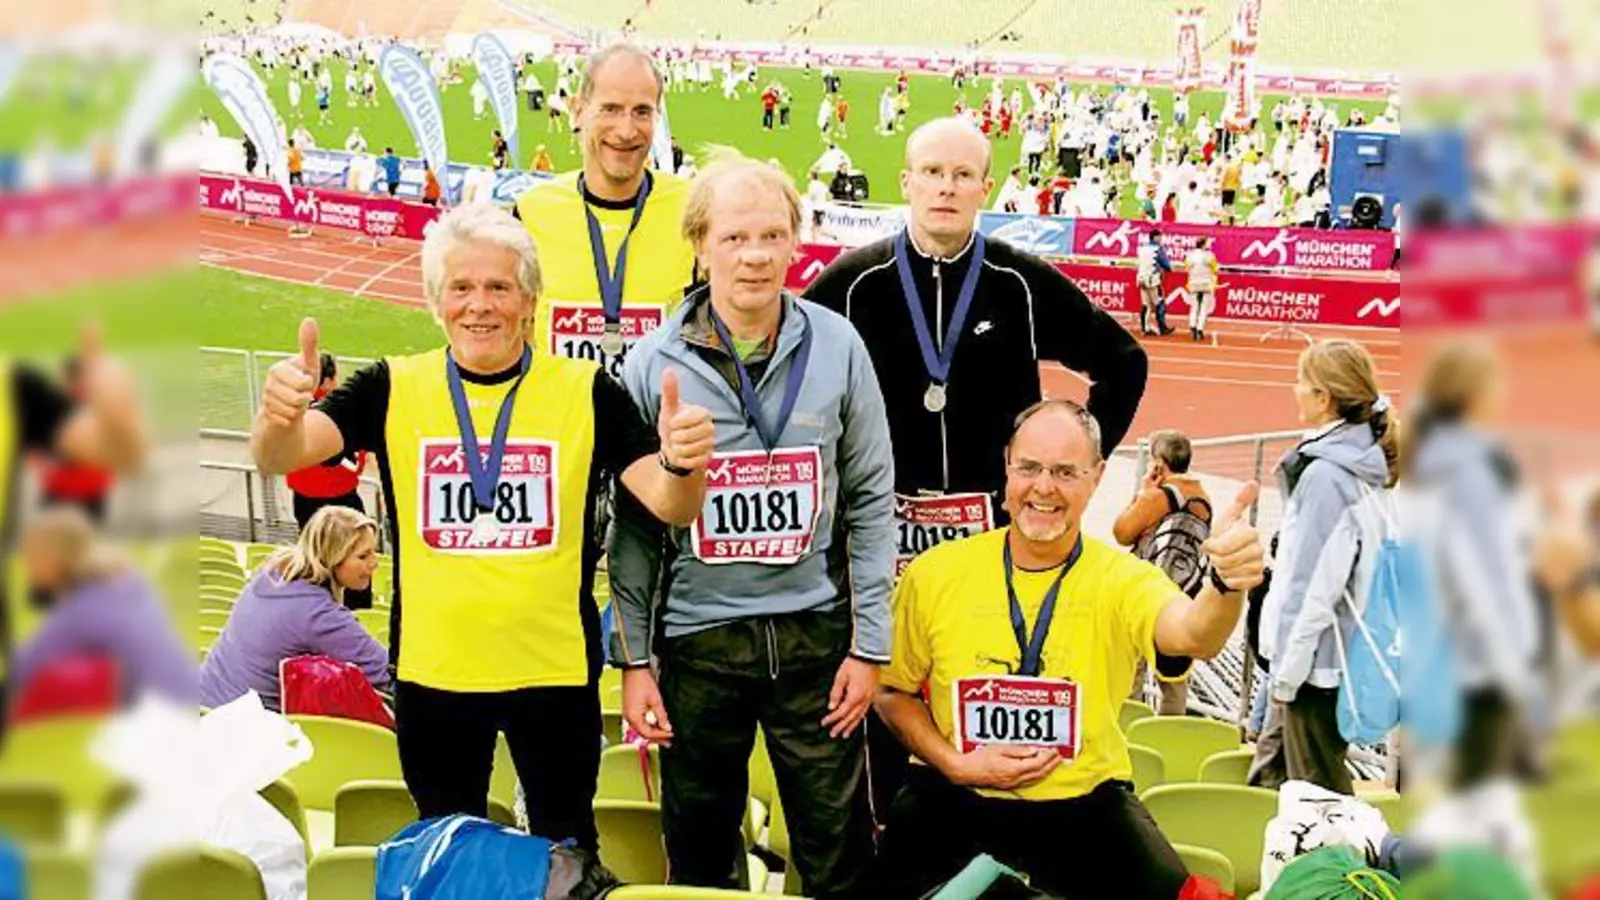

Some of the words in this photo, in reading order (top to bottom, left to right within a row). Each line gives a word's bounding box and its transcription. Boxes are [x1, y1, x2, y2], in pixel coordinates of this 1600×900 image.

[1137, 232, 1216, 251] MNCH
[1295, 239, 1372, 256] MÜNCHEN
[1294, 254, 1373, 269] MARATHON
[1072, 277, 1125, 295] CHEN
[1227, 286, 1321, 307] MÜNCHEN
[1225, 303, 1319, 320] MARATHON
[439, 481, 533, 524] 1081
[711, 489, 803, 534] 10181
[437, 529, 538, 548] STAFEL
[714, 538, 803, 556] STAFFEL
[975, 704, 1058, 742] 10181
